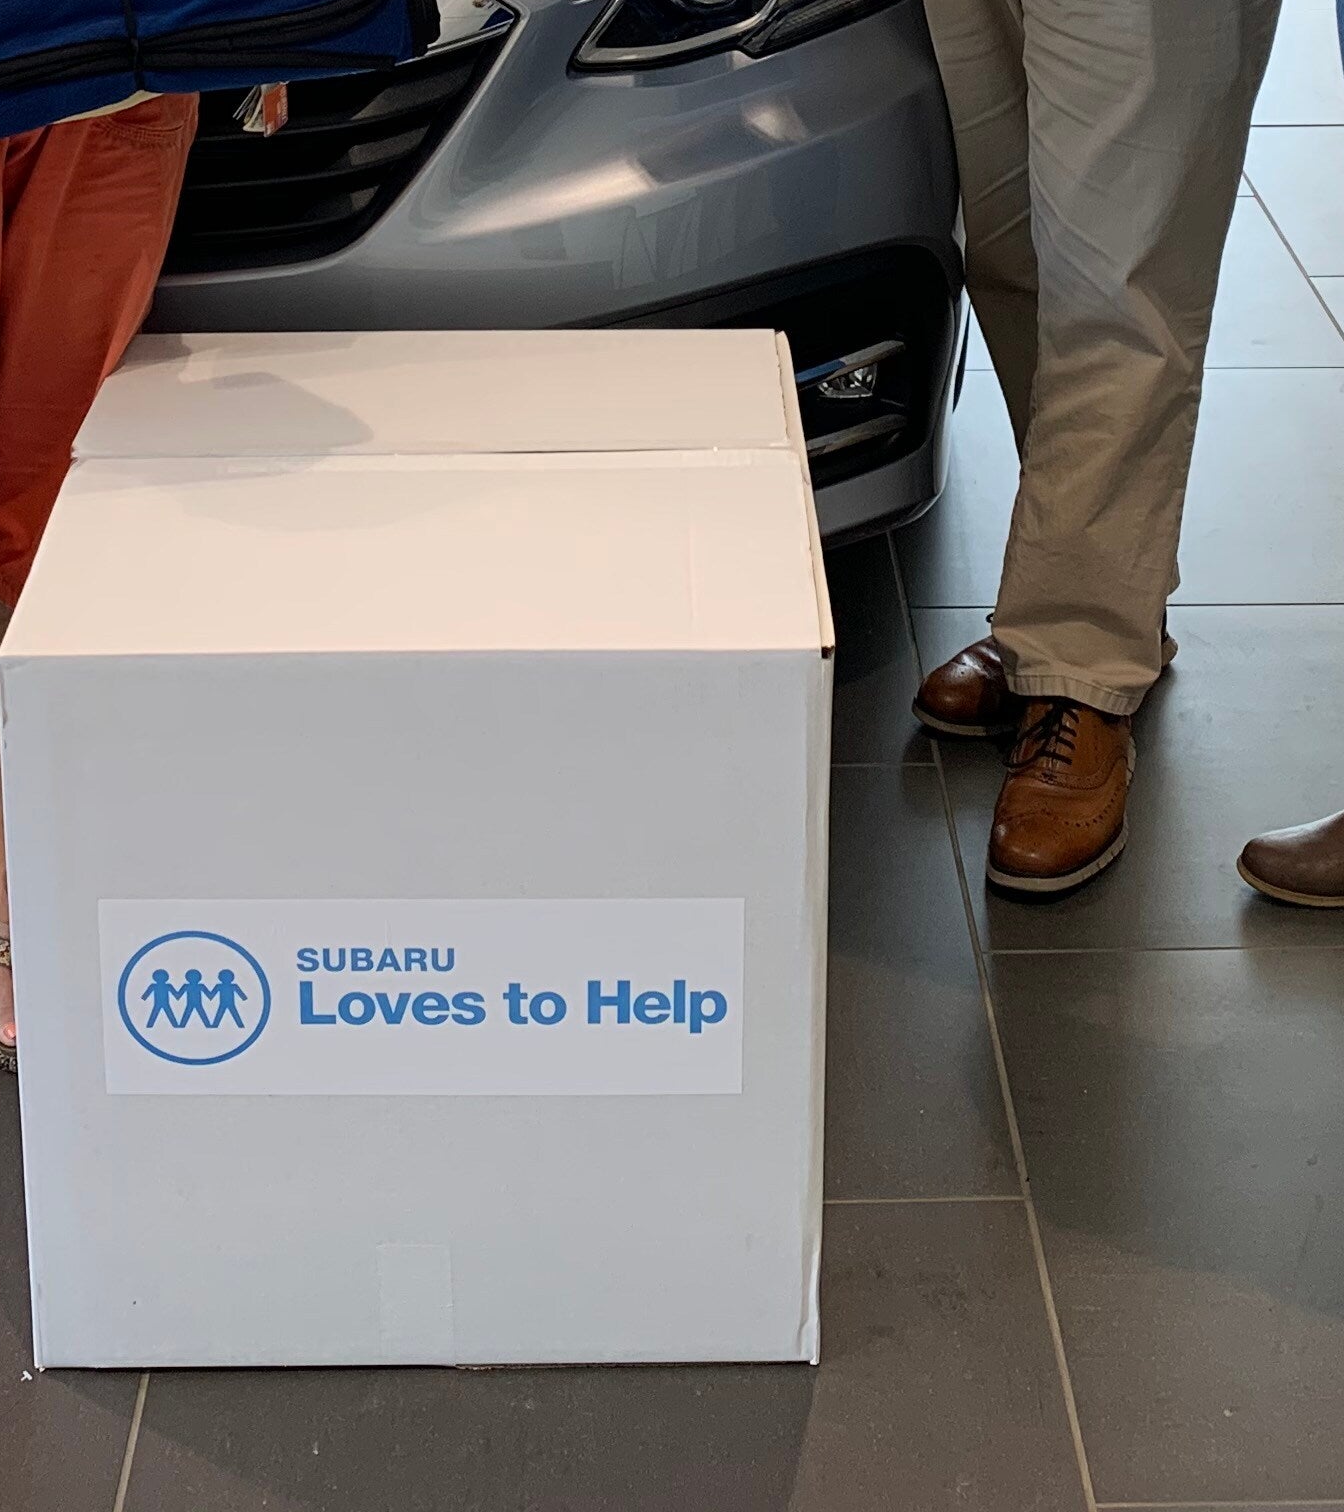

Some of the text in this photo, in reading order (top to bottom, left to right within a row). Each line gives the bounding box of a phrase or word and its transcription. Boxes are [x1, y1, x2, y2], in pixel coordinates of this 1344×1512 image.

[296, 946, 456, 973] SUBARU
[299, 978, 729, 1035] Loves to Help
